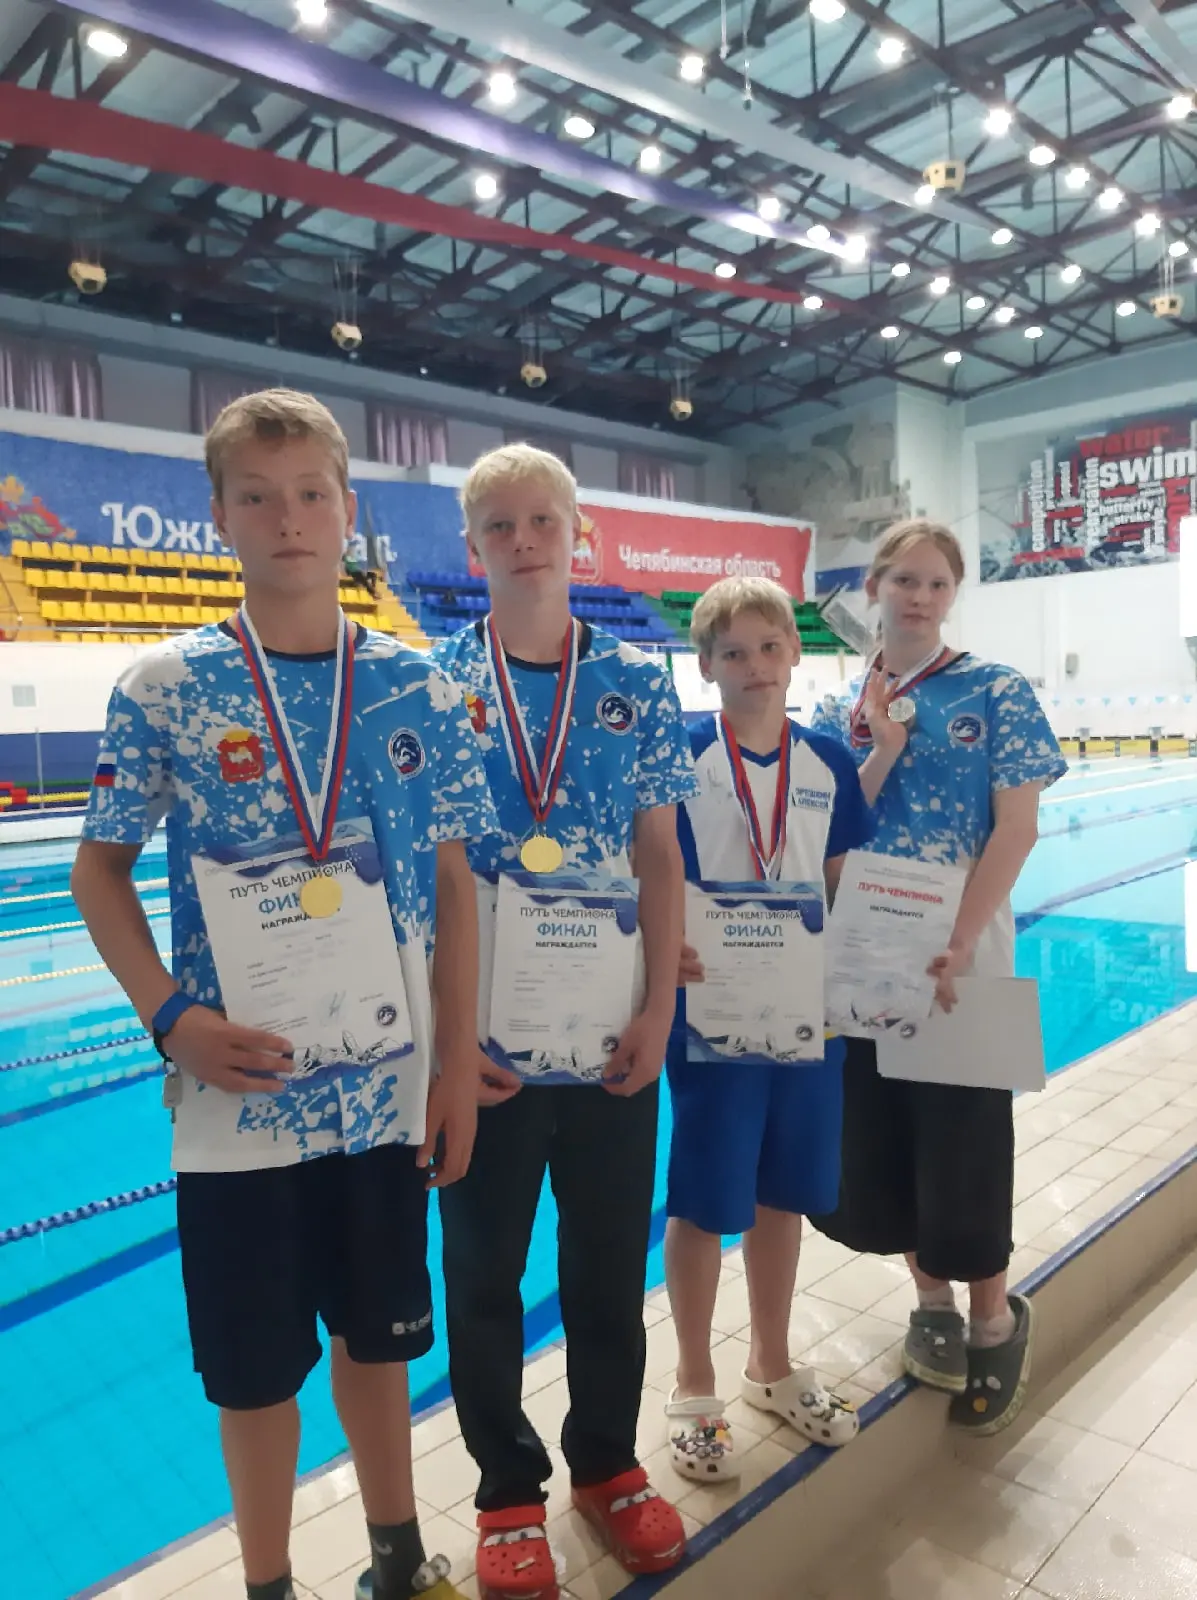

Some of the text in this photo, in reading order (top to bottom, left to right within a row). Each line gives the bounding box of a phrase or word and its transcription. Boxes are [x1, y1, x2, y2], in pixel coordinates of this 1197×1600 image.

[618, 544, 781, 578] Челябинская область
[229, 861, 355, 900] ПУТЬ ЧЕМПИОНА
[857, 881, 944, 905] ПУТЬ ЧЕМПИОНА
[520, 907, 617, 920] ПУТЬ ЧЕМПИОНА
[705, 910, 801, 921] ПУТЬ ЧЕМПИОНА
[537, 922, 597, 938] ФИНАЛ
[723, 925, 783, 938] ФИНАЛ
[535, 941, 597, 949] НАГРАЖДАЕТСЯ
